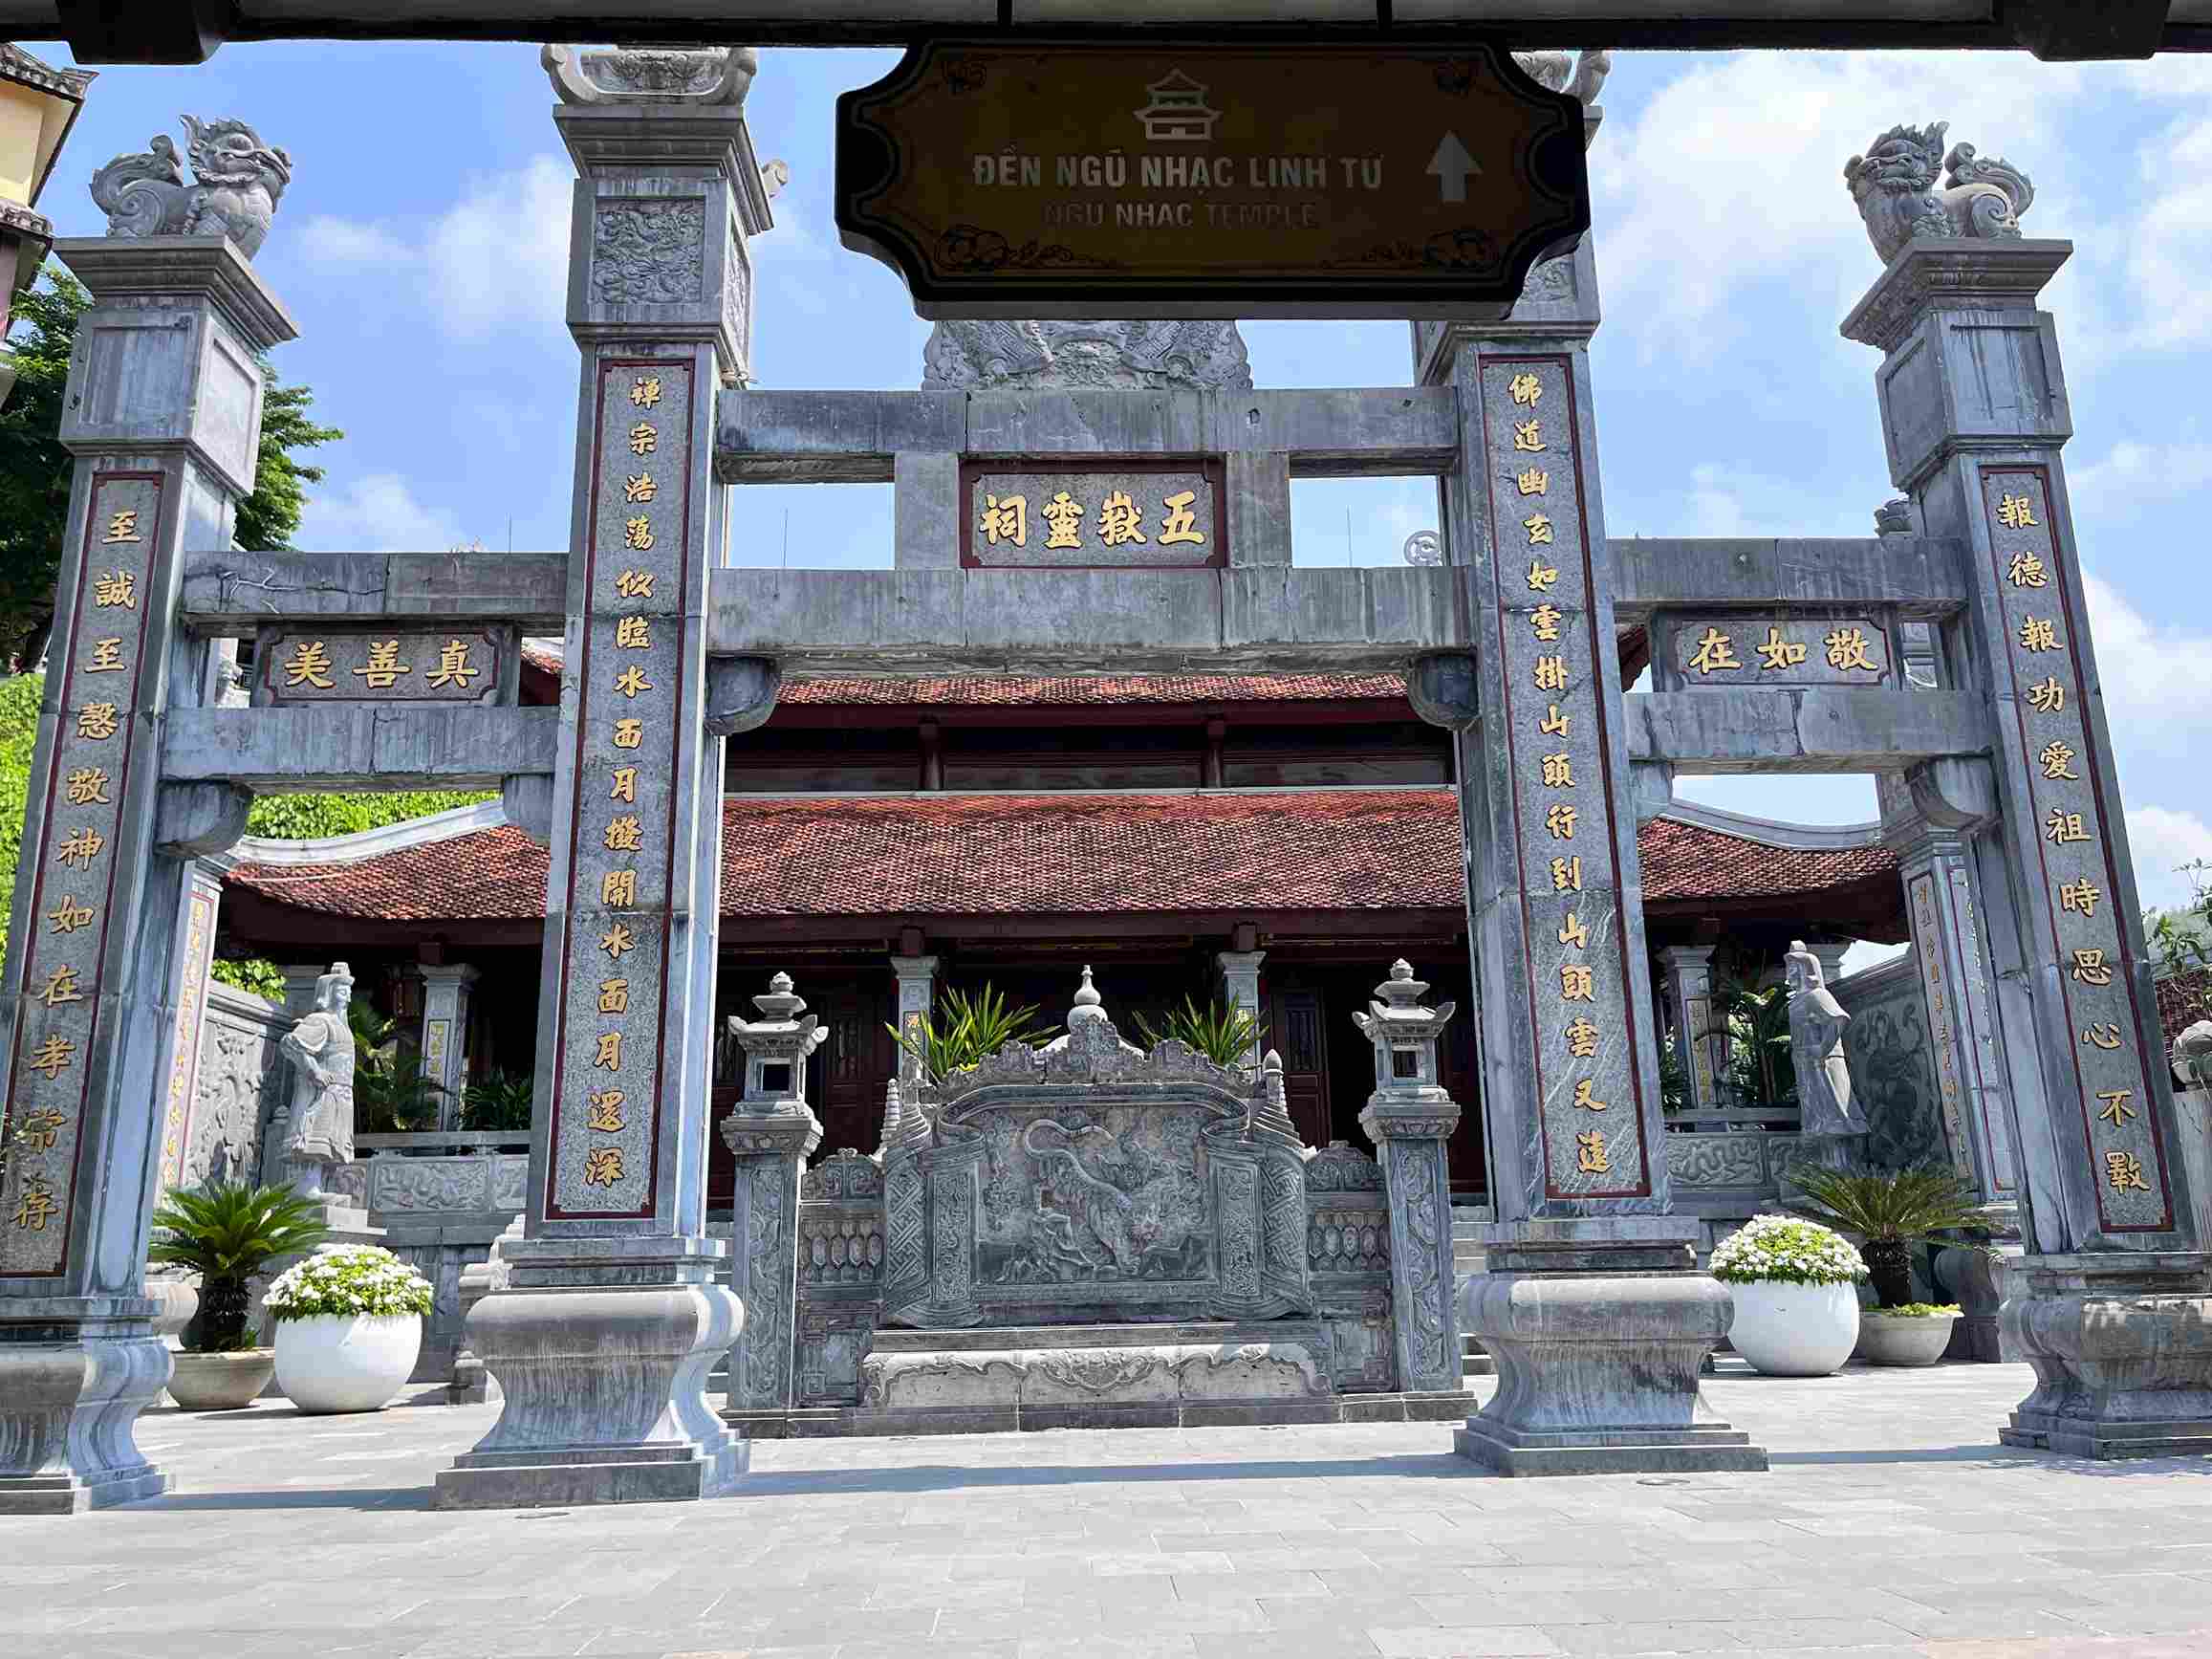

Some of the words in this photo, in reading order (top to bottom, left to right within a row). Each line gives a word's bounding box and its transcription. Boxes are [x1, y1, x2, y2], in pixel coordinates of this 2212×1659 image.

[1055, 148, 1126, 187] NGŨ
[1140, 155, 1233, 195] NHẠC
[1248, 156, 1326, 187] LINH
[1116, 202, 1194, 229] NHAC
[1203, 202, 1317, 229] TEMPLE
